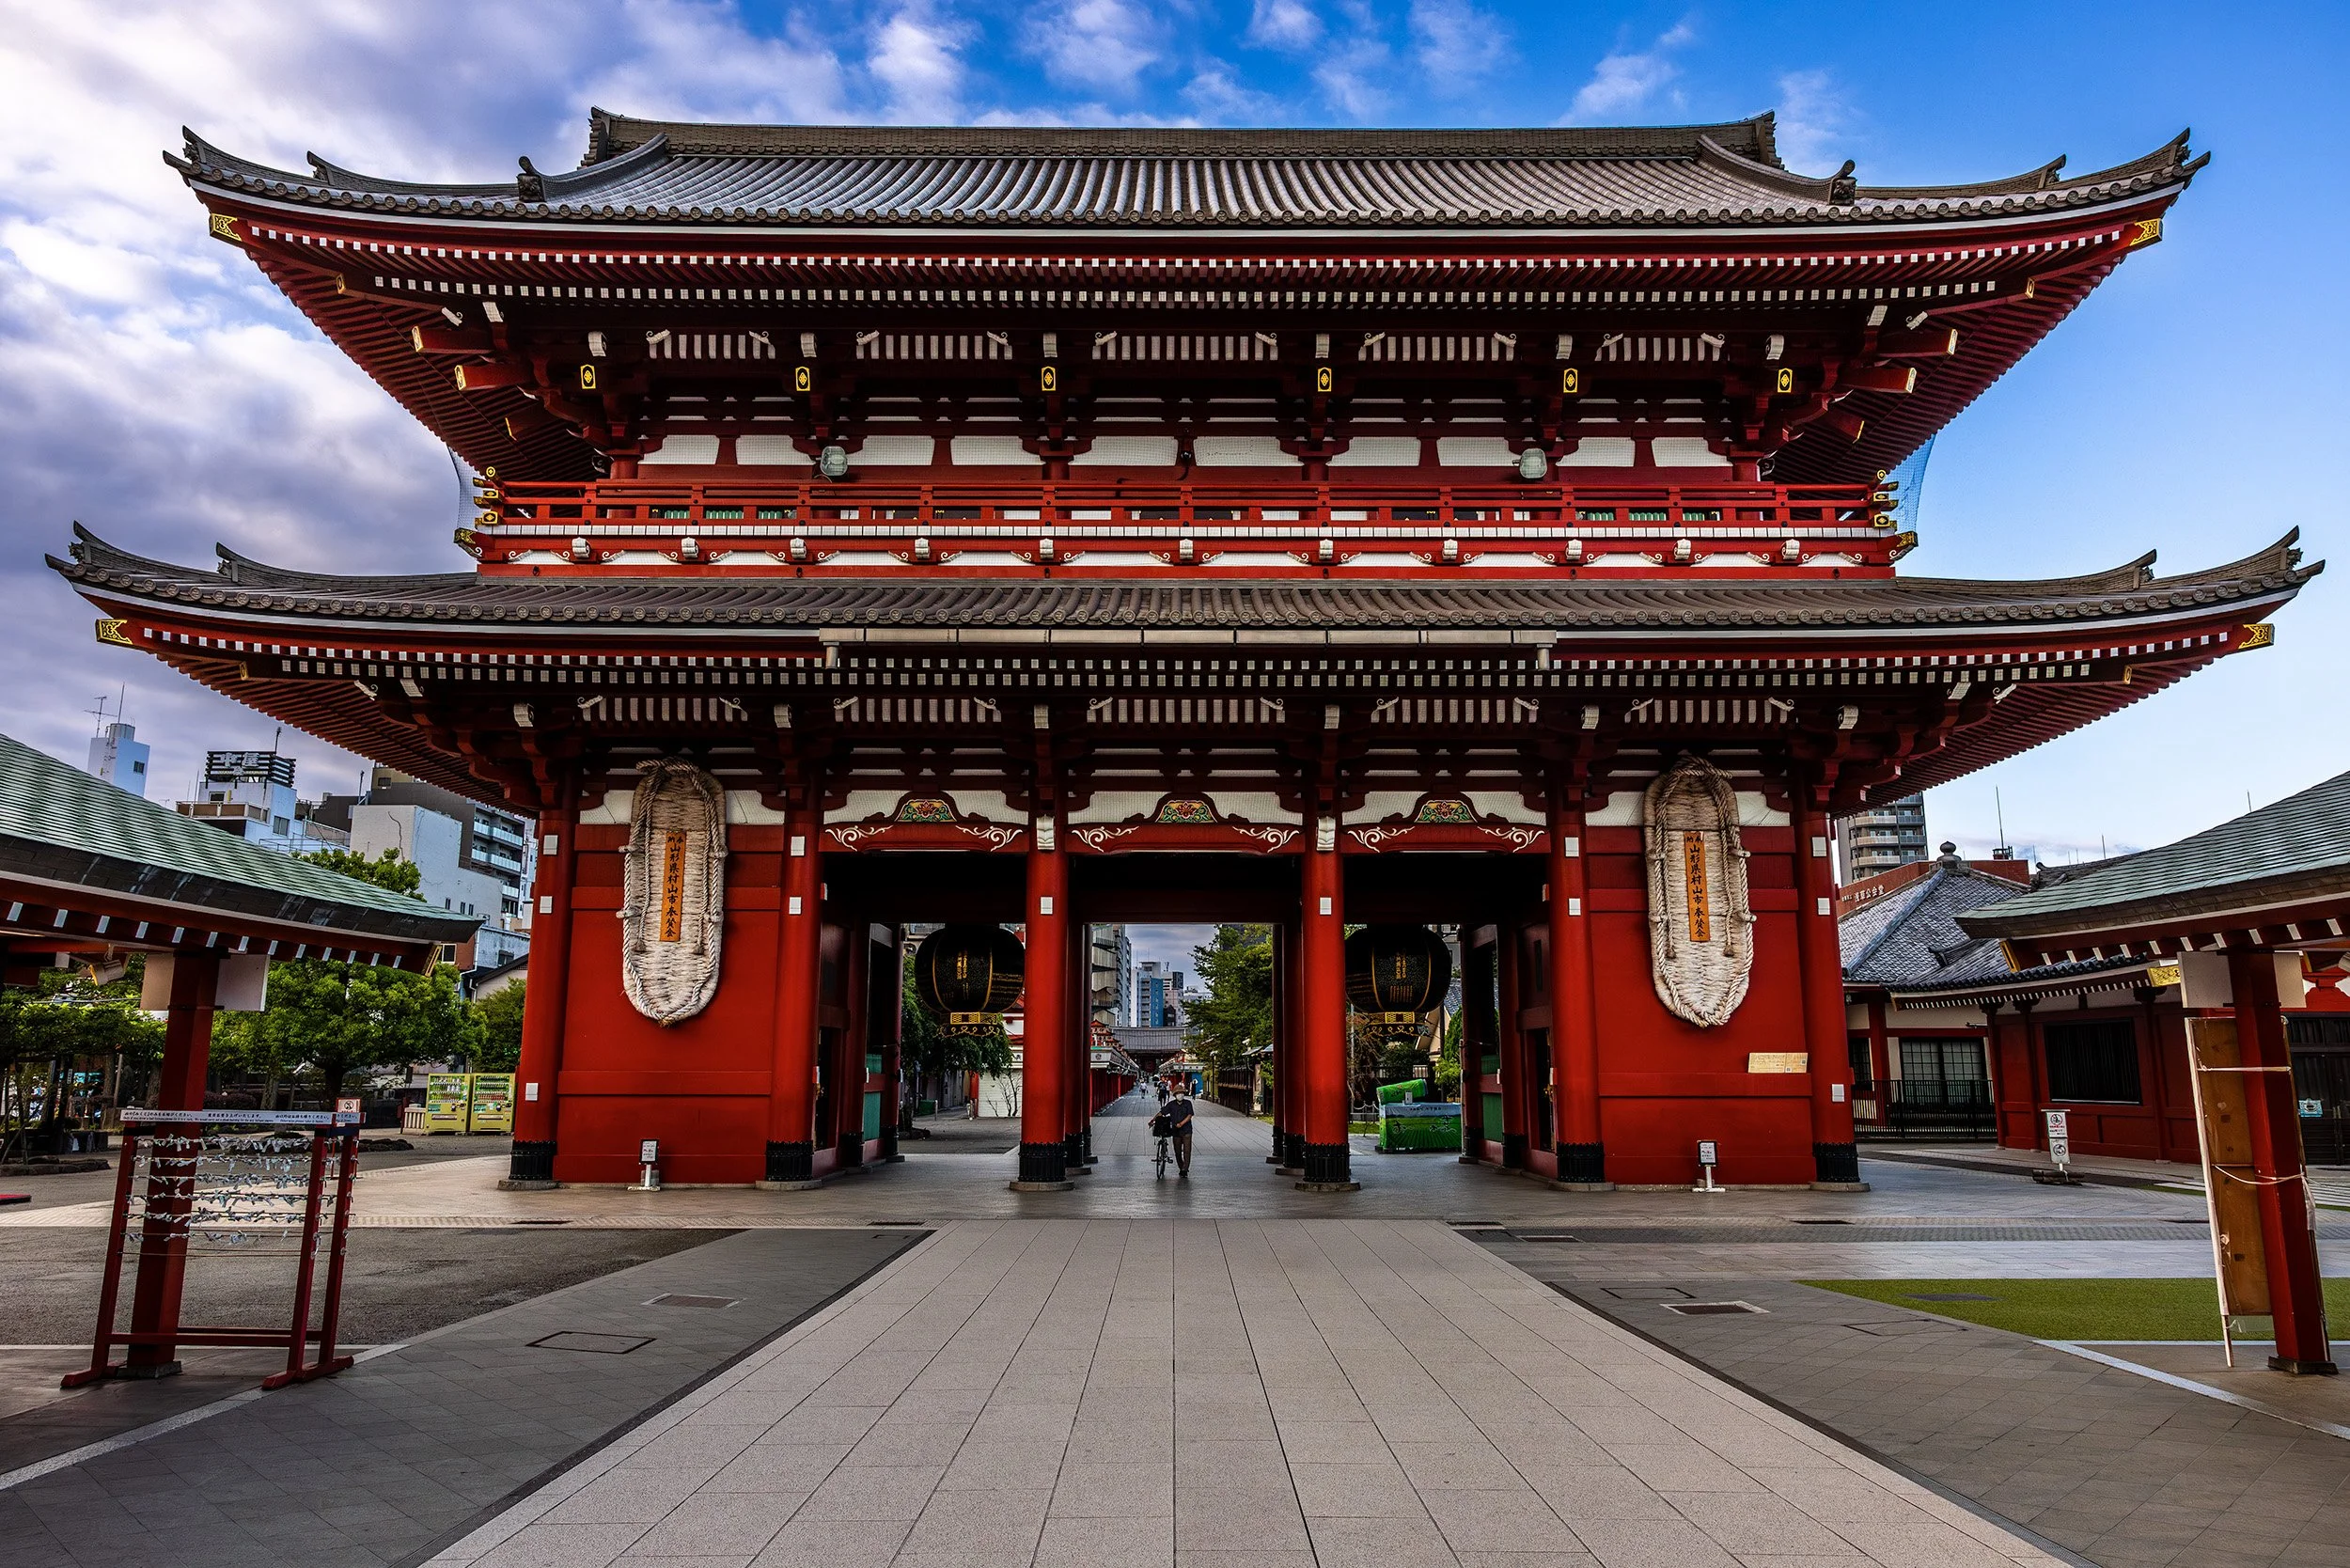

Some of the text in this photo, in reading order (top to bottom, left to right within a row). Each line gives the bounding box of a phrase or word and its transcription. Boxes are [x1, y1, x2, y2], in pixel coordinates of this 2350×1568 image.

[665, 843, 681, 937] 山形県村山市奉賛会
[1689, 843, 1706, 937] 山形県村山市奉賛会
